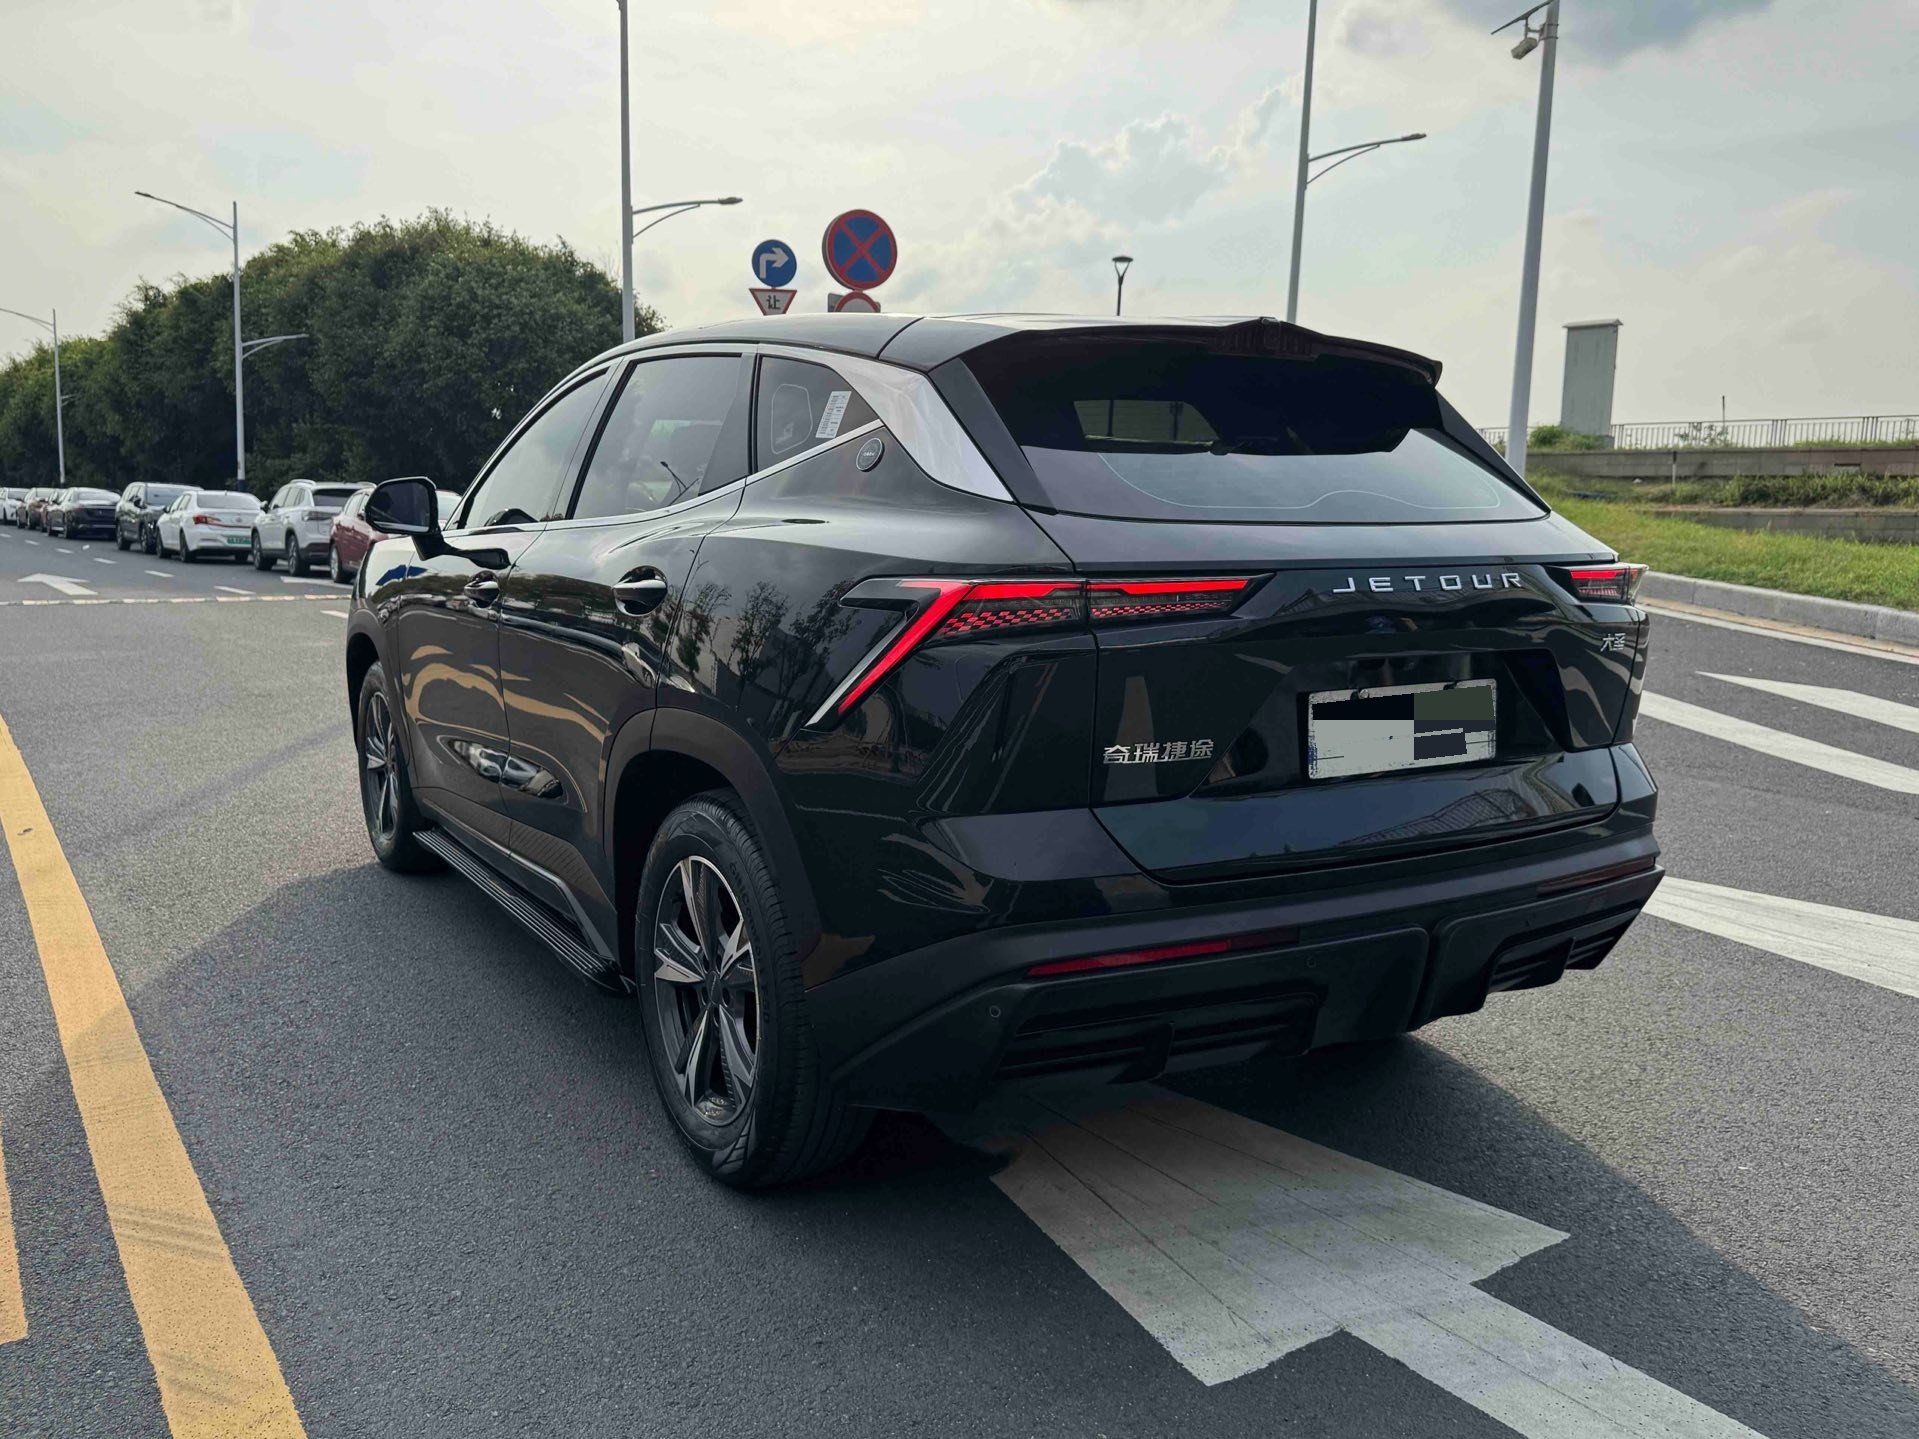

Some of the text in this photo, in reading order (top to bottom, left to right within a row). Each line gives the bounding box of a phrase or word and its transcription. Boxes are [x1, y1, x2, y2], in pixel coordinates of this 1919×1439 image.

[766, 294, 781, 310] 让
[1333, 572, 1523, 594] JETOUR
[1102, 738, 1214, 764] 奇瑞捷途
